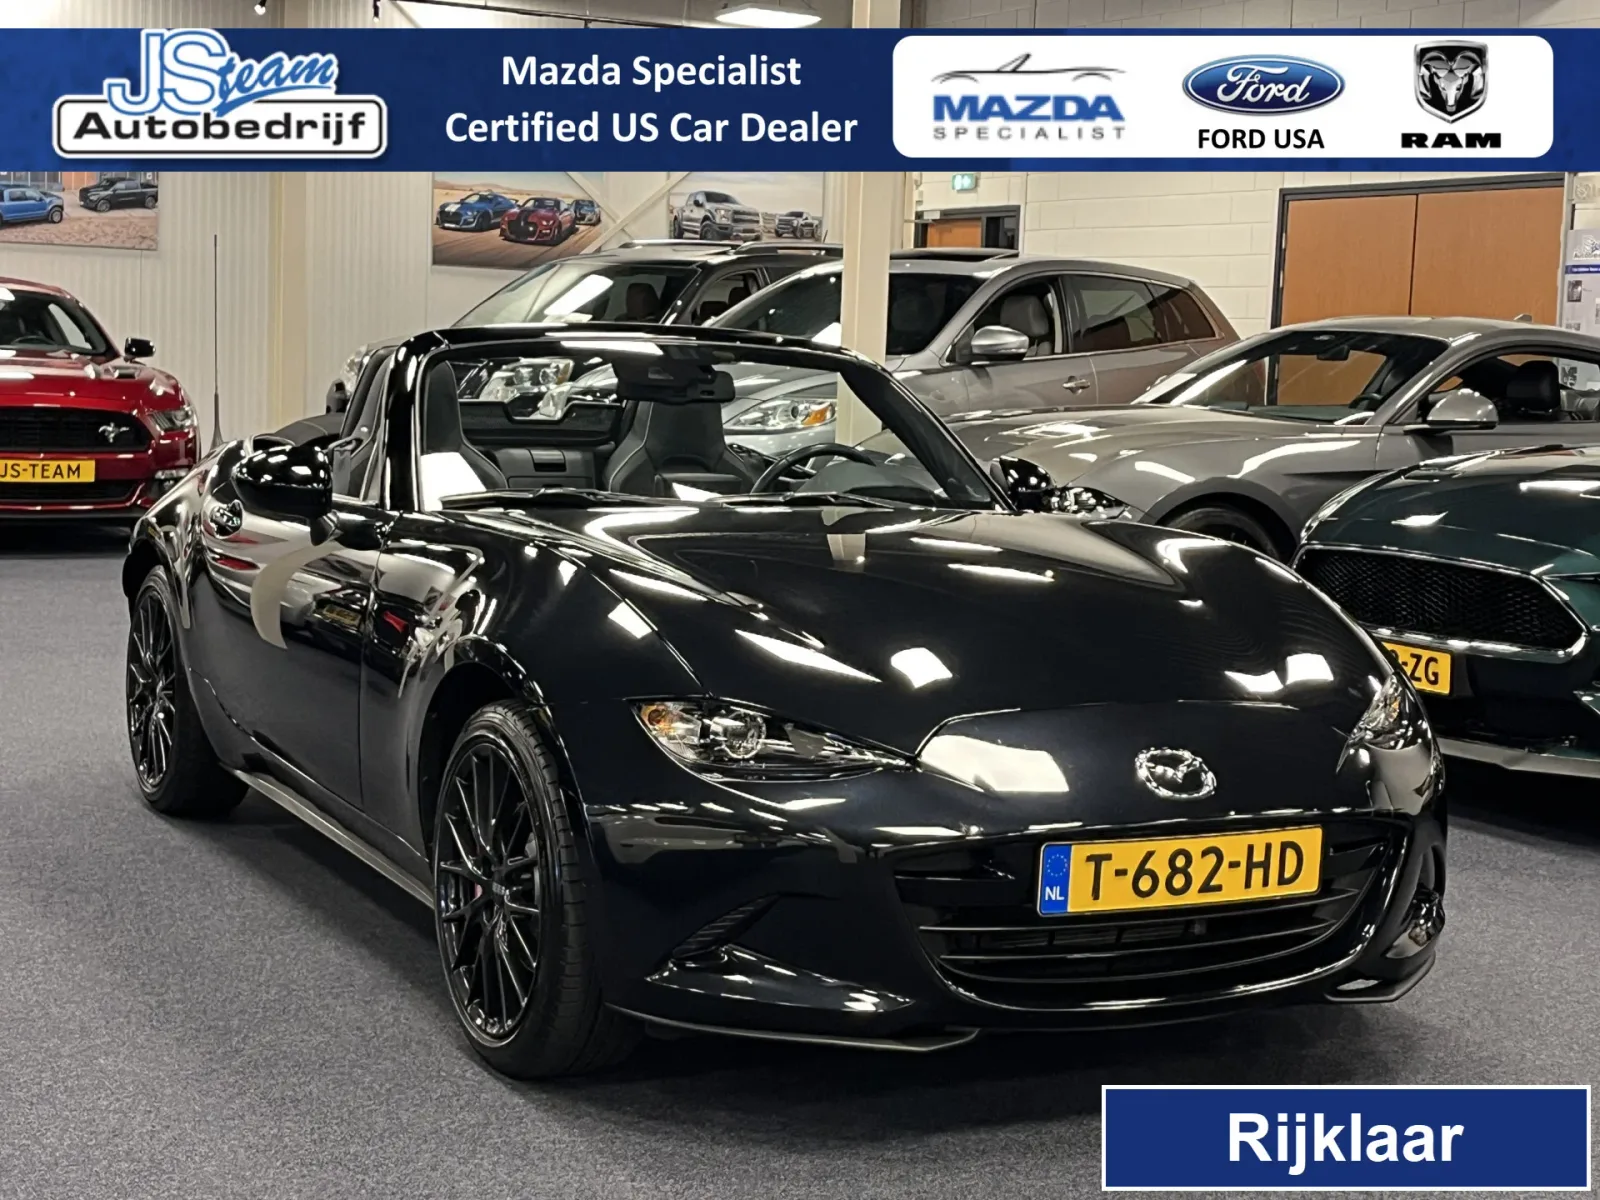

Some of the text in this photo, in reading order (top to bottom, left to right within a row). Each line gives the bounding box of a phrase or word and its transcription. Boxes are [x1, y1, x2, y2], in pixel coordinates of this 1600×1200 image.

[0, 463, 81, 479] JS-TEAM
[1045, 840, 1305, 901] NL T-682-HD
